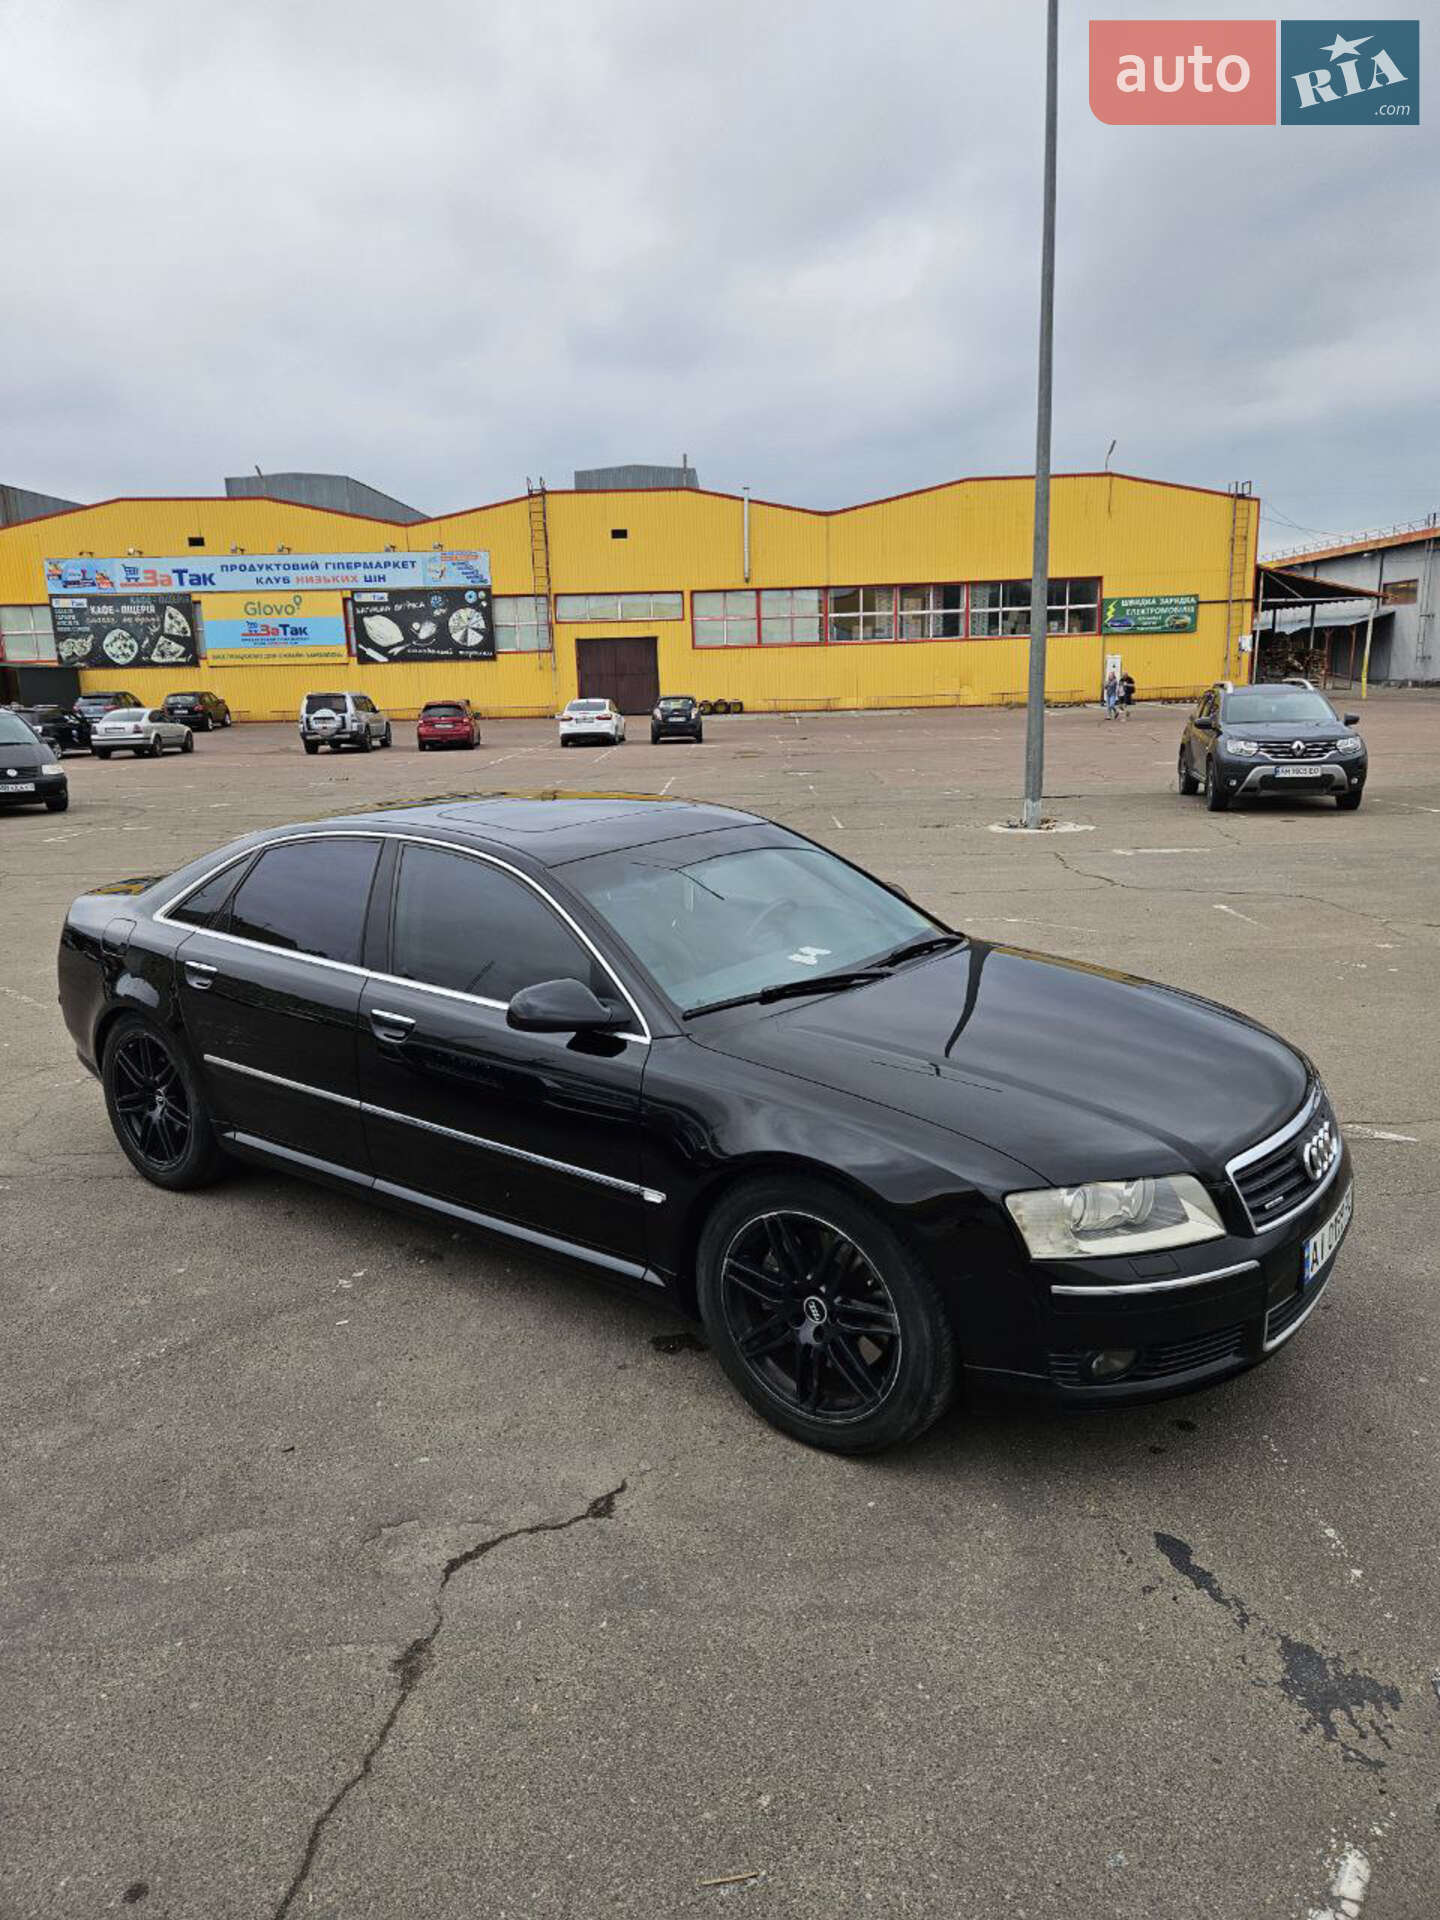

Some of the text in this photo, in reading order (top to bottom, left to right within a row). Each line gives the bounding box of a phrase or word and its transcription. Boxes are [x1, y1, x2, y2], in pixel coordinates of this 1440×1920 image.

[220, 560, 417, 573] ПРОДУКТОВИЙ ГІПЕРМАРКЕТ
[143, 568, 216, 587] ЗаТак
[256, 574, 387, 585] КЛУБ НИЗЬКИХ ЦІН
[244, 601, 295, 616] Glovo
[260, 623, 309, 637] ЗаТак
